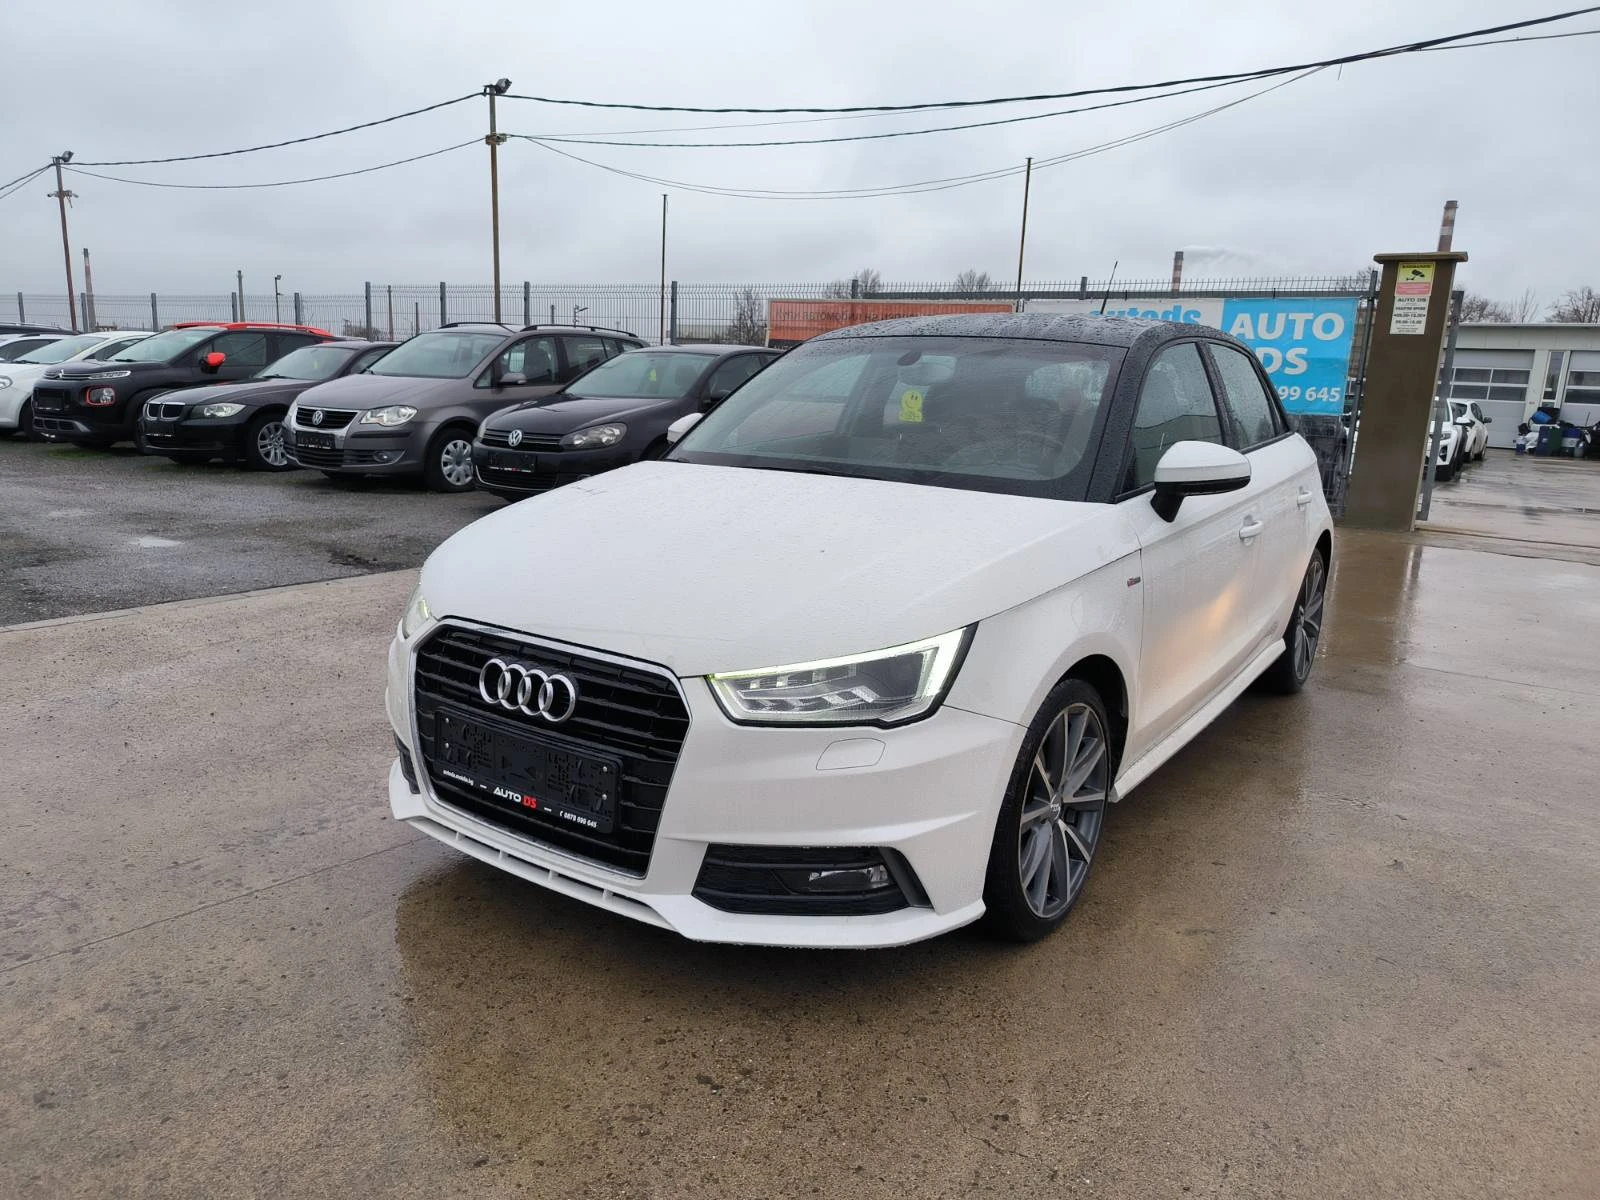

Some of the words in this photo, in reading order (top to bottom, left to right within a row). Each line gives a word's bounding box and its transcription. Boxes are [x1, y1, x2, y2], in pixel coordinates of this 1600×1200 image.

[1229, 312, 1345, 341] AUTO
[1255, 346, 1309, 376] DS
[1274, 385, 1302, 401] 99
[1305, 386, 1341, 403] 645
[493, 786, 522, 803] AUTO
[523, 795, 537, 809] DS
